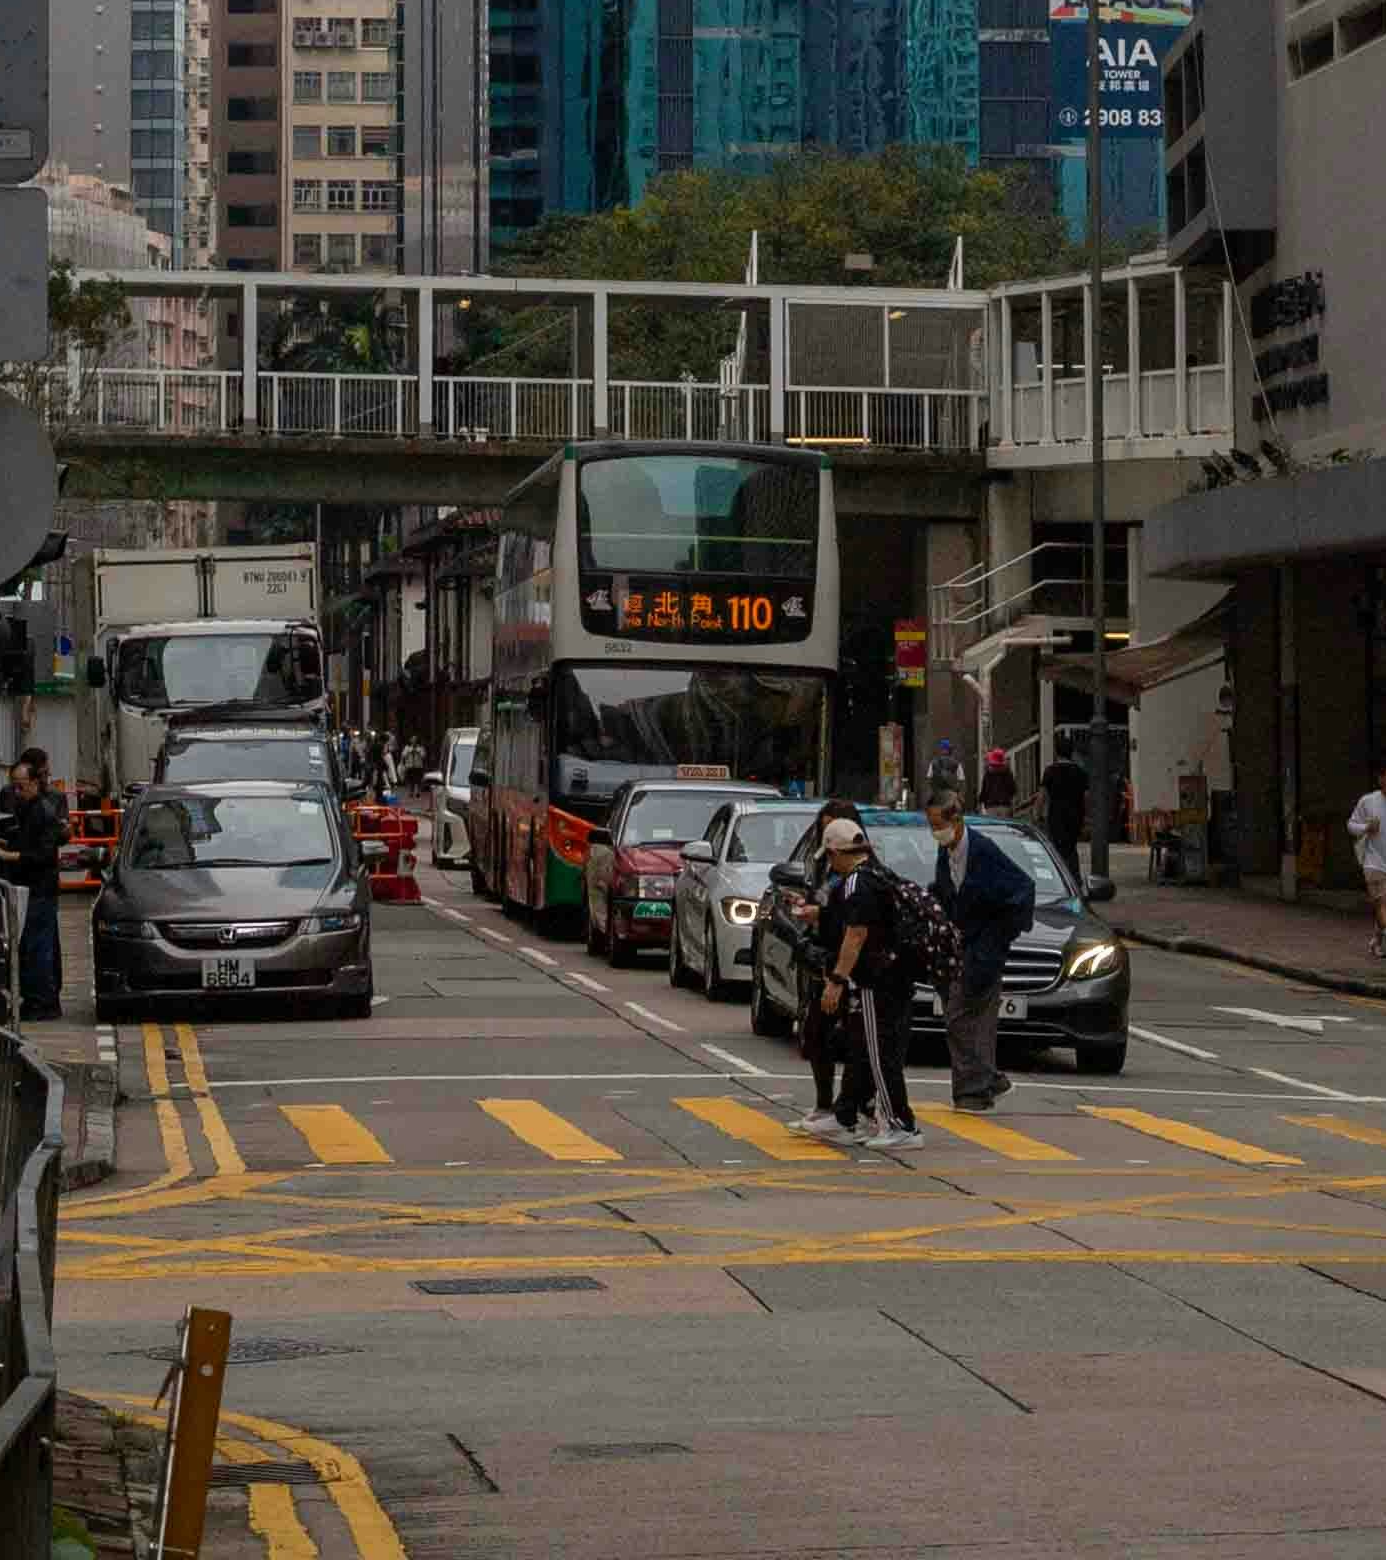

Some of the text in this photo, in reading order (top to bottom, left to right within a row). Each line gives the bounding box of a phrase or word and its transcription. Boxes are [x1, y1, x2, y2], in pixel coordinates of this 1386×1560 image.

[1086, 38, 1158, 67] AIA
[1104, 70, 1141, 80] TOWER
[1138, 108, 1163, 127] 83
[727, 594, 774, 632] 110
